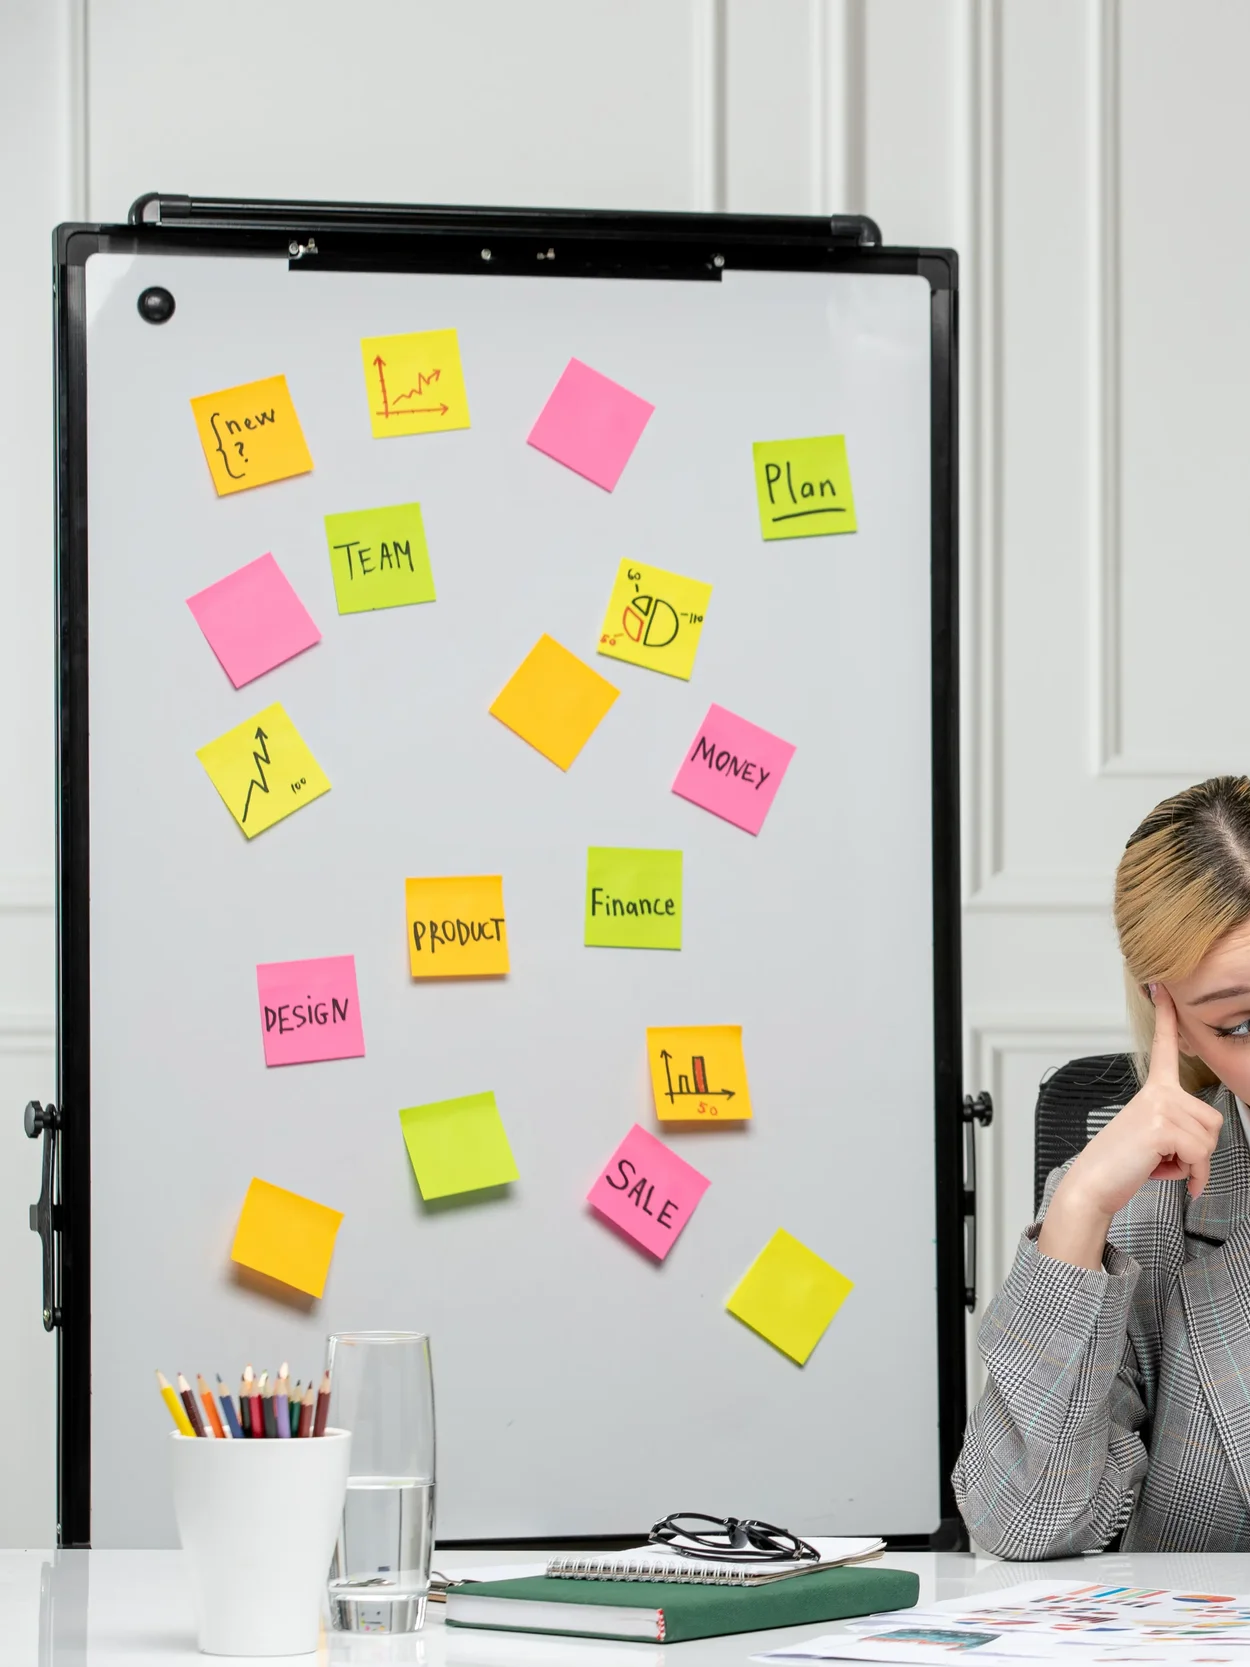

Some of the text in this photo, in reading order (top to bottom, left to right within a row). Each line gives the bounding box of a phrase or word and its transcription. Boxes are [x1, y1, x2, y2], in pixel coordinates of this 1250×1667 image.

[225, 409, 275, 434] new
[764, 461, 836, 504] Plan
[333, 540, 415, 580] TEAM
[627, 568, 641, 580] 60
[690, 736, 771, 790] MONEY
[290, 777, 307, 794] 100
[591, 887, 676, 916] Finance
[413, 917, 505, 953] PRODUCT
[697, 1101, 718, 1116] 50
[605, 1159, 679, 1229] SALE
